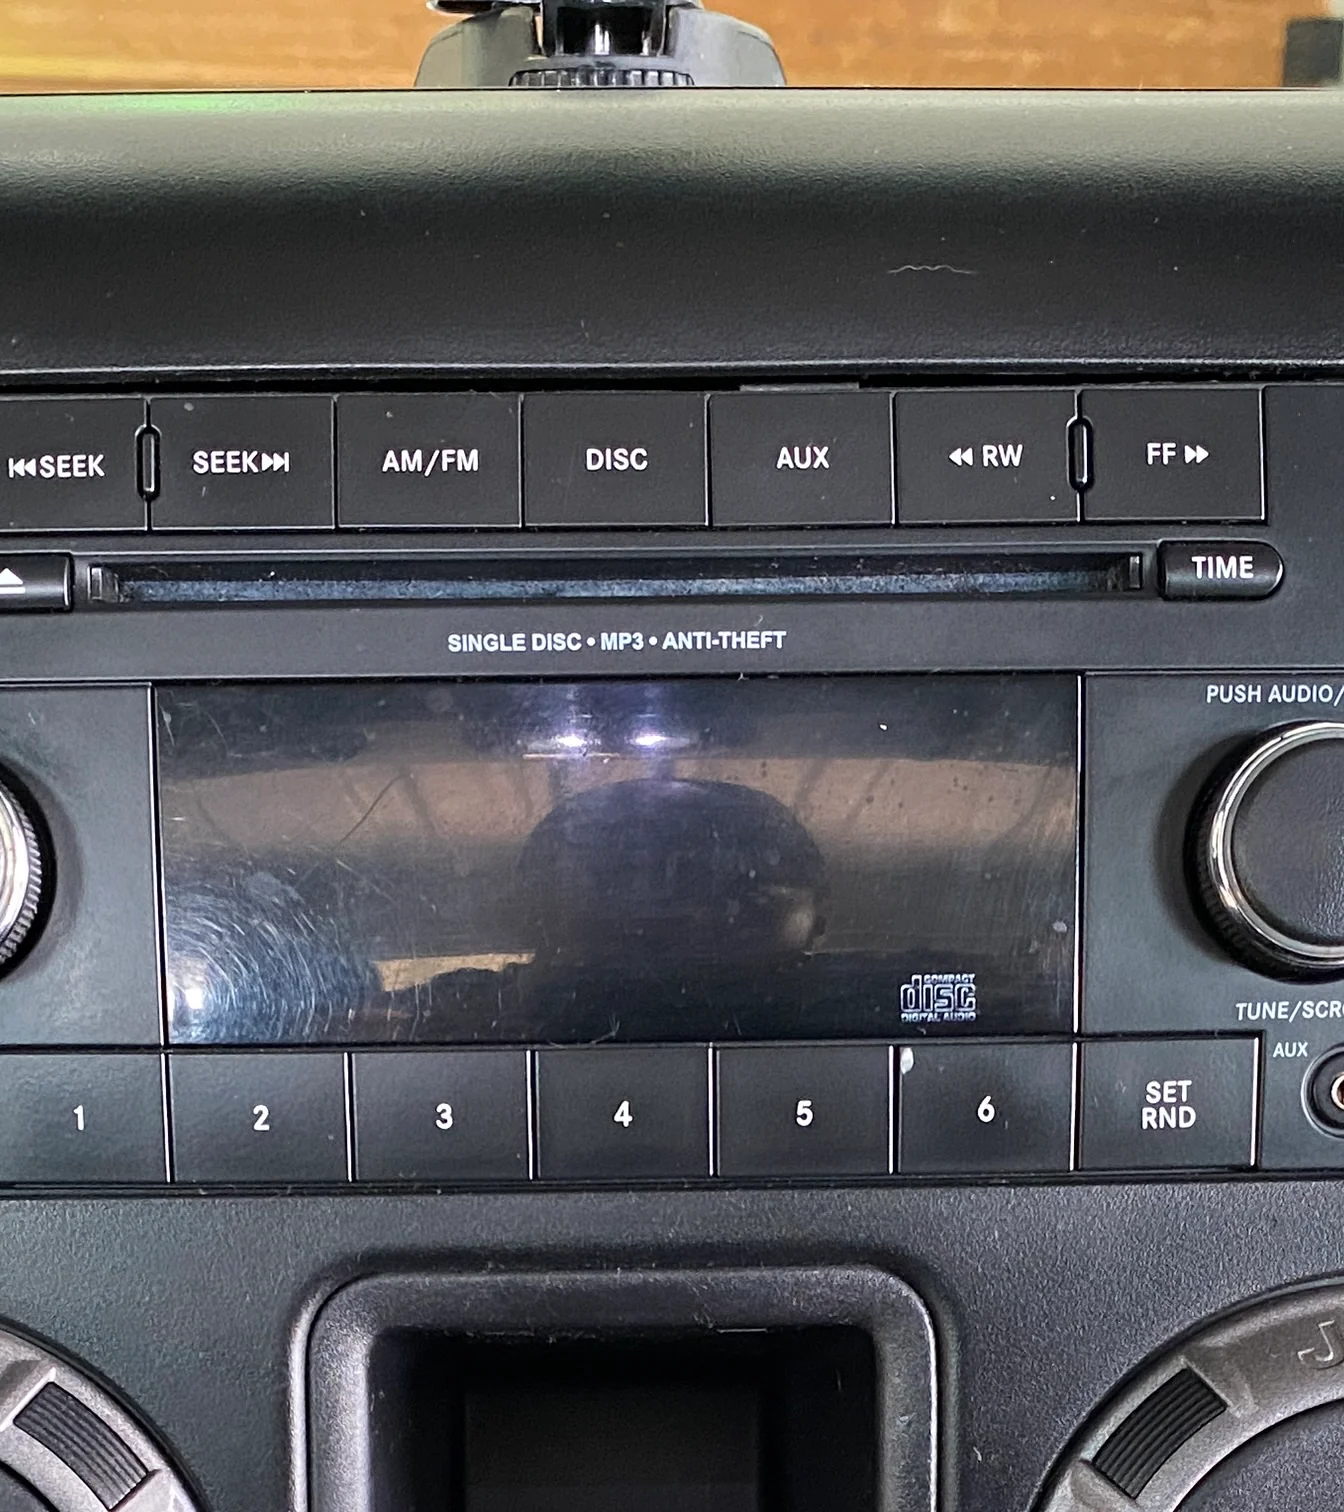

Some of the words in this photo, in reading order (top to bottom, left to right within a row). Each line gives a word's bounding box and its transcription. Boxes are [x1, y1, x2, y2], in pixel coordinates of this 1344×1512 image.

[39, 453, 105, 479] SEEK
[193, 450, 258, 474] SEEK
[382, 448, 479, 477] AM/FM
[586, 447, 648, 471] DISC
[776, 445, 830, 469] AUX
[982, 443, 1023, 467] RW
[1147, 442, 1177, 465] FF
[1191, 555, 1255, 580] TIME
[447, 633, 527, 653] SINGLE
[531, 632, 583, 652] DISC
[600, 631, 645, 651] MP3
[661, 630, 787, 650] ANTI-THEFT
[1206, 684, 1262, 704] PUSH
[923, 973, 976, 984] COMPACT
[943, 1011, 976, 1021] AUDIO
[1272, 1041, 1309, 1059] AUX
[1145, 1079, 1193, 1104] SET
[73, 1104, 85, 1131] 1
[252, 1104, 270, 1131] 2
[435, 1102, 453, 1130] 3
[613, 1100, 633, 1128] 4
[796, 1099, 814, 1127] 5
[977, 1095, 995, 1123] 6
[1141, 1105, 1198, 1130] RND
